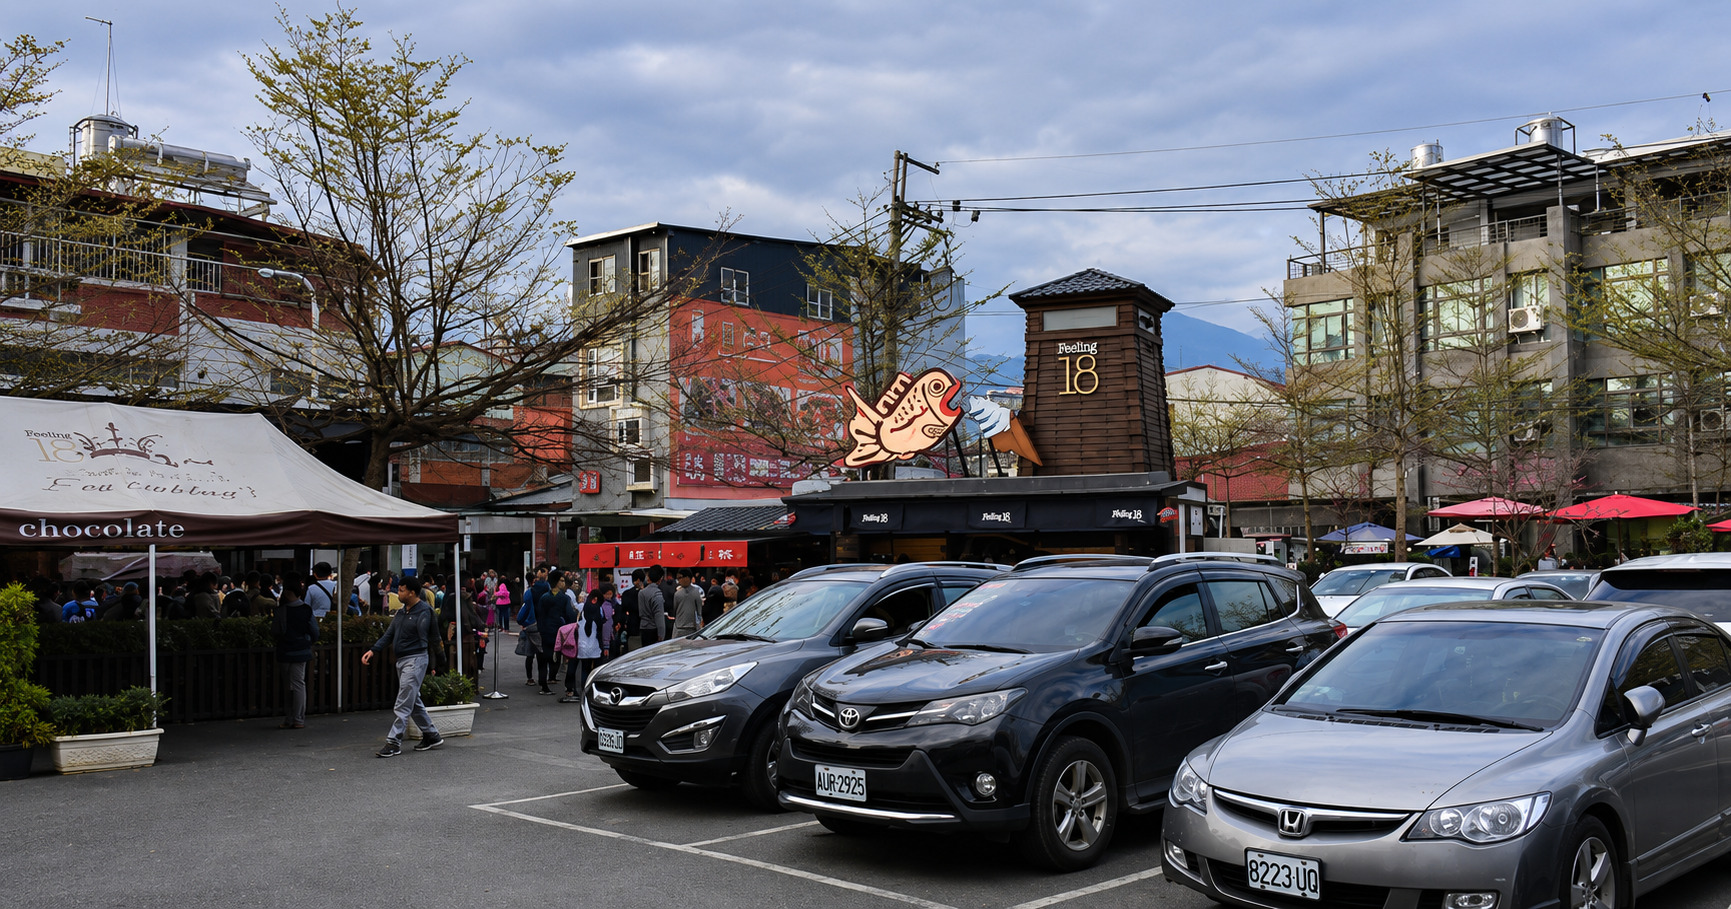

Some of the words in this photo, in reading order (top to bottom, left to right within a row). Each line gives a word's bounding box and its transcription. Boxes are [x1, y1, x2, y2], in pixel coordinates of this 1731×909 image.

[1057, 341, 1098, 355] Feeling
[1058, 354, 1099, 395] 18
[29, 437, 84, 463] 18
[880, 512, 889, 524] 18
[1002, 511, 1011, 522] 18
[1132, 509, 1142, 520] 18
[18, 517, 185, 539] chocolate
[817, 771, 865, 796] AUR-2925
